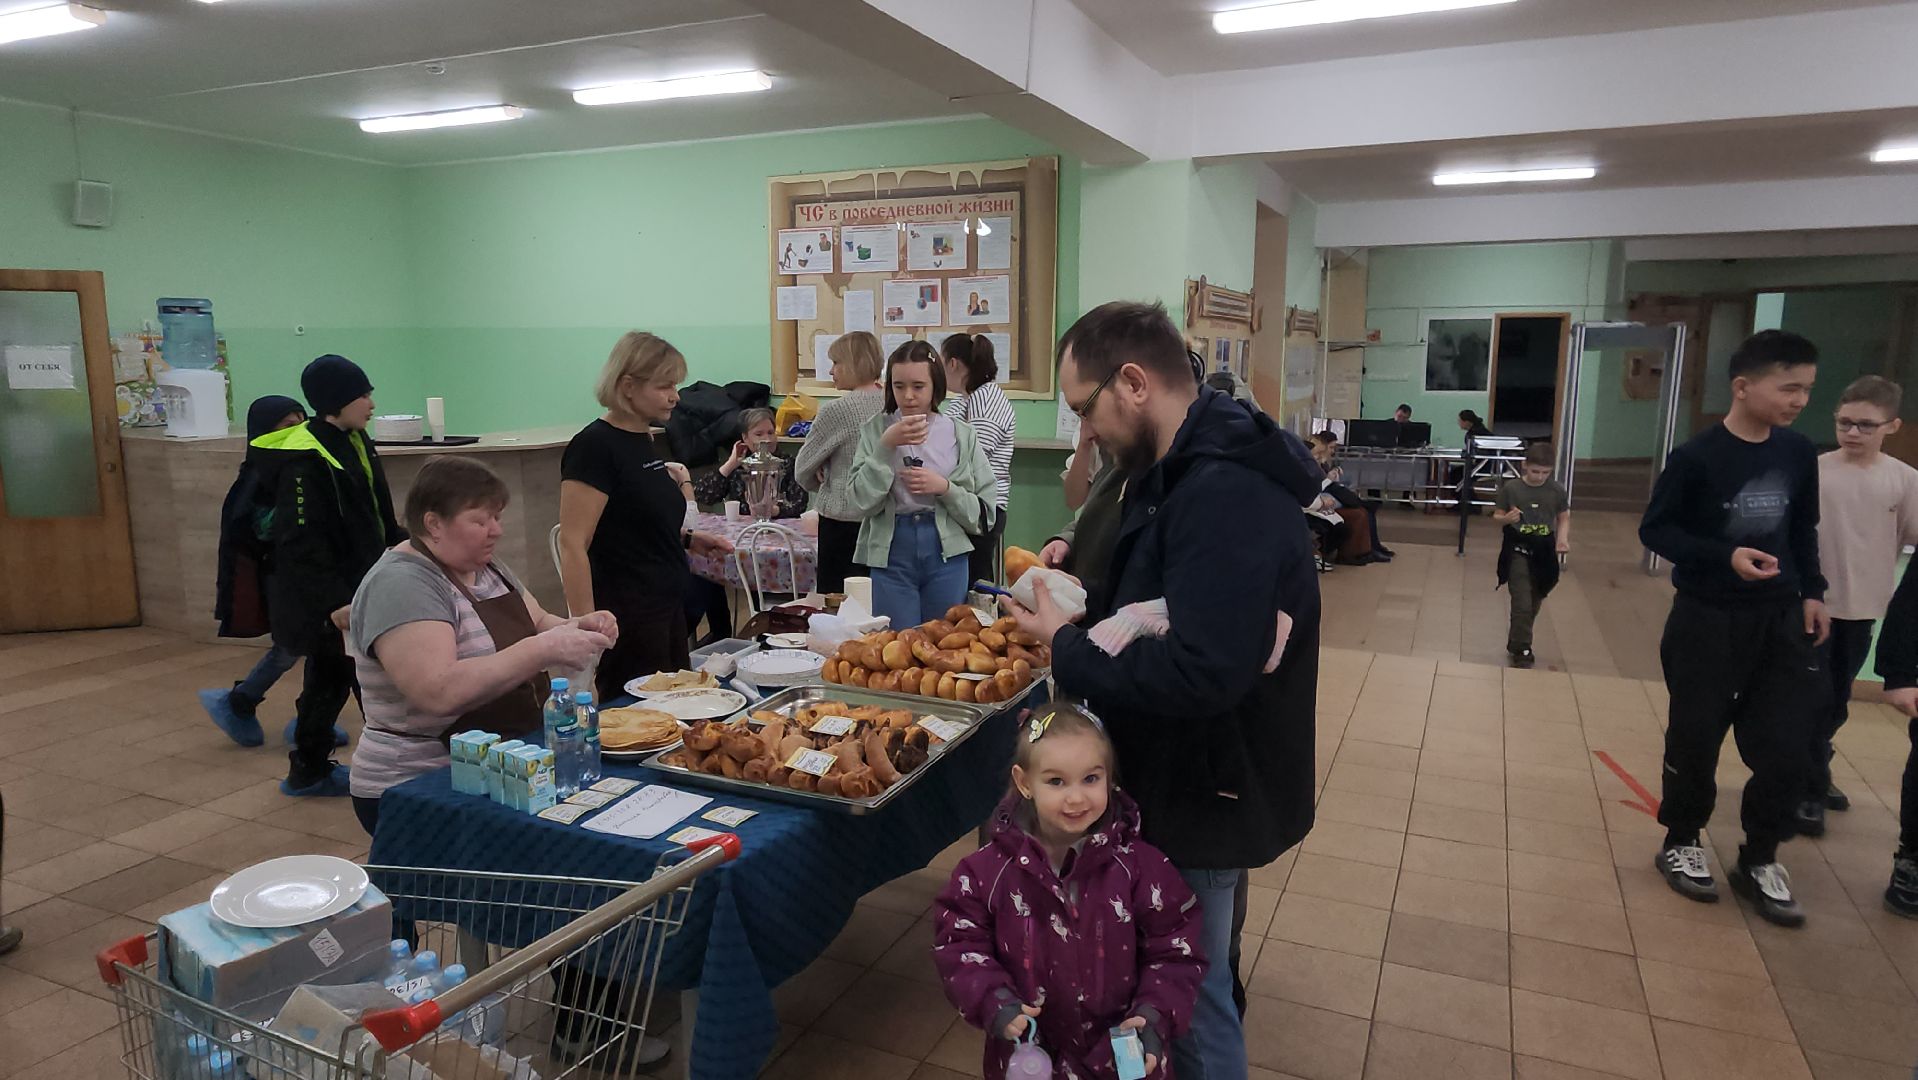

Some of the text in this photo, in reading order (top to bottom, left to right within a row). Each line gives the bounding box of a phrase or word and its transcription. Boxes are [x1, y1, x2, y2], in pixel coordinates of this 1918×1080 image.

[799, 205, 824, 222] ЧС
[959, 199, 1014, 214] ЖИЗНИ
[19, 363, 33, 371] ОТ
